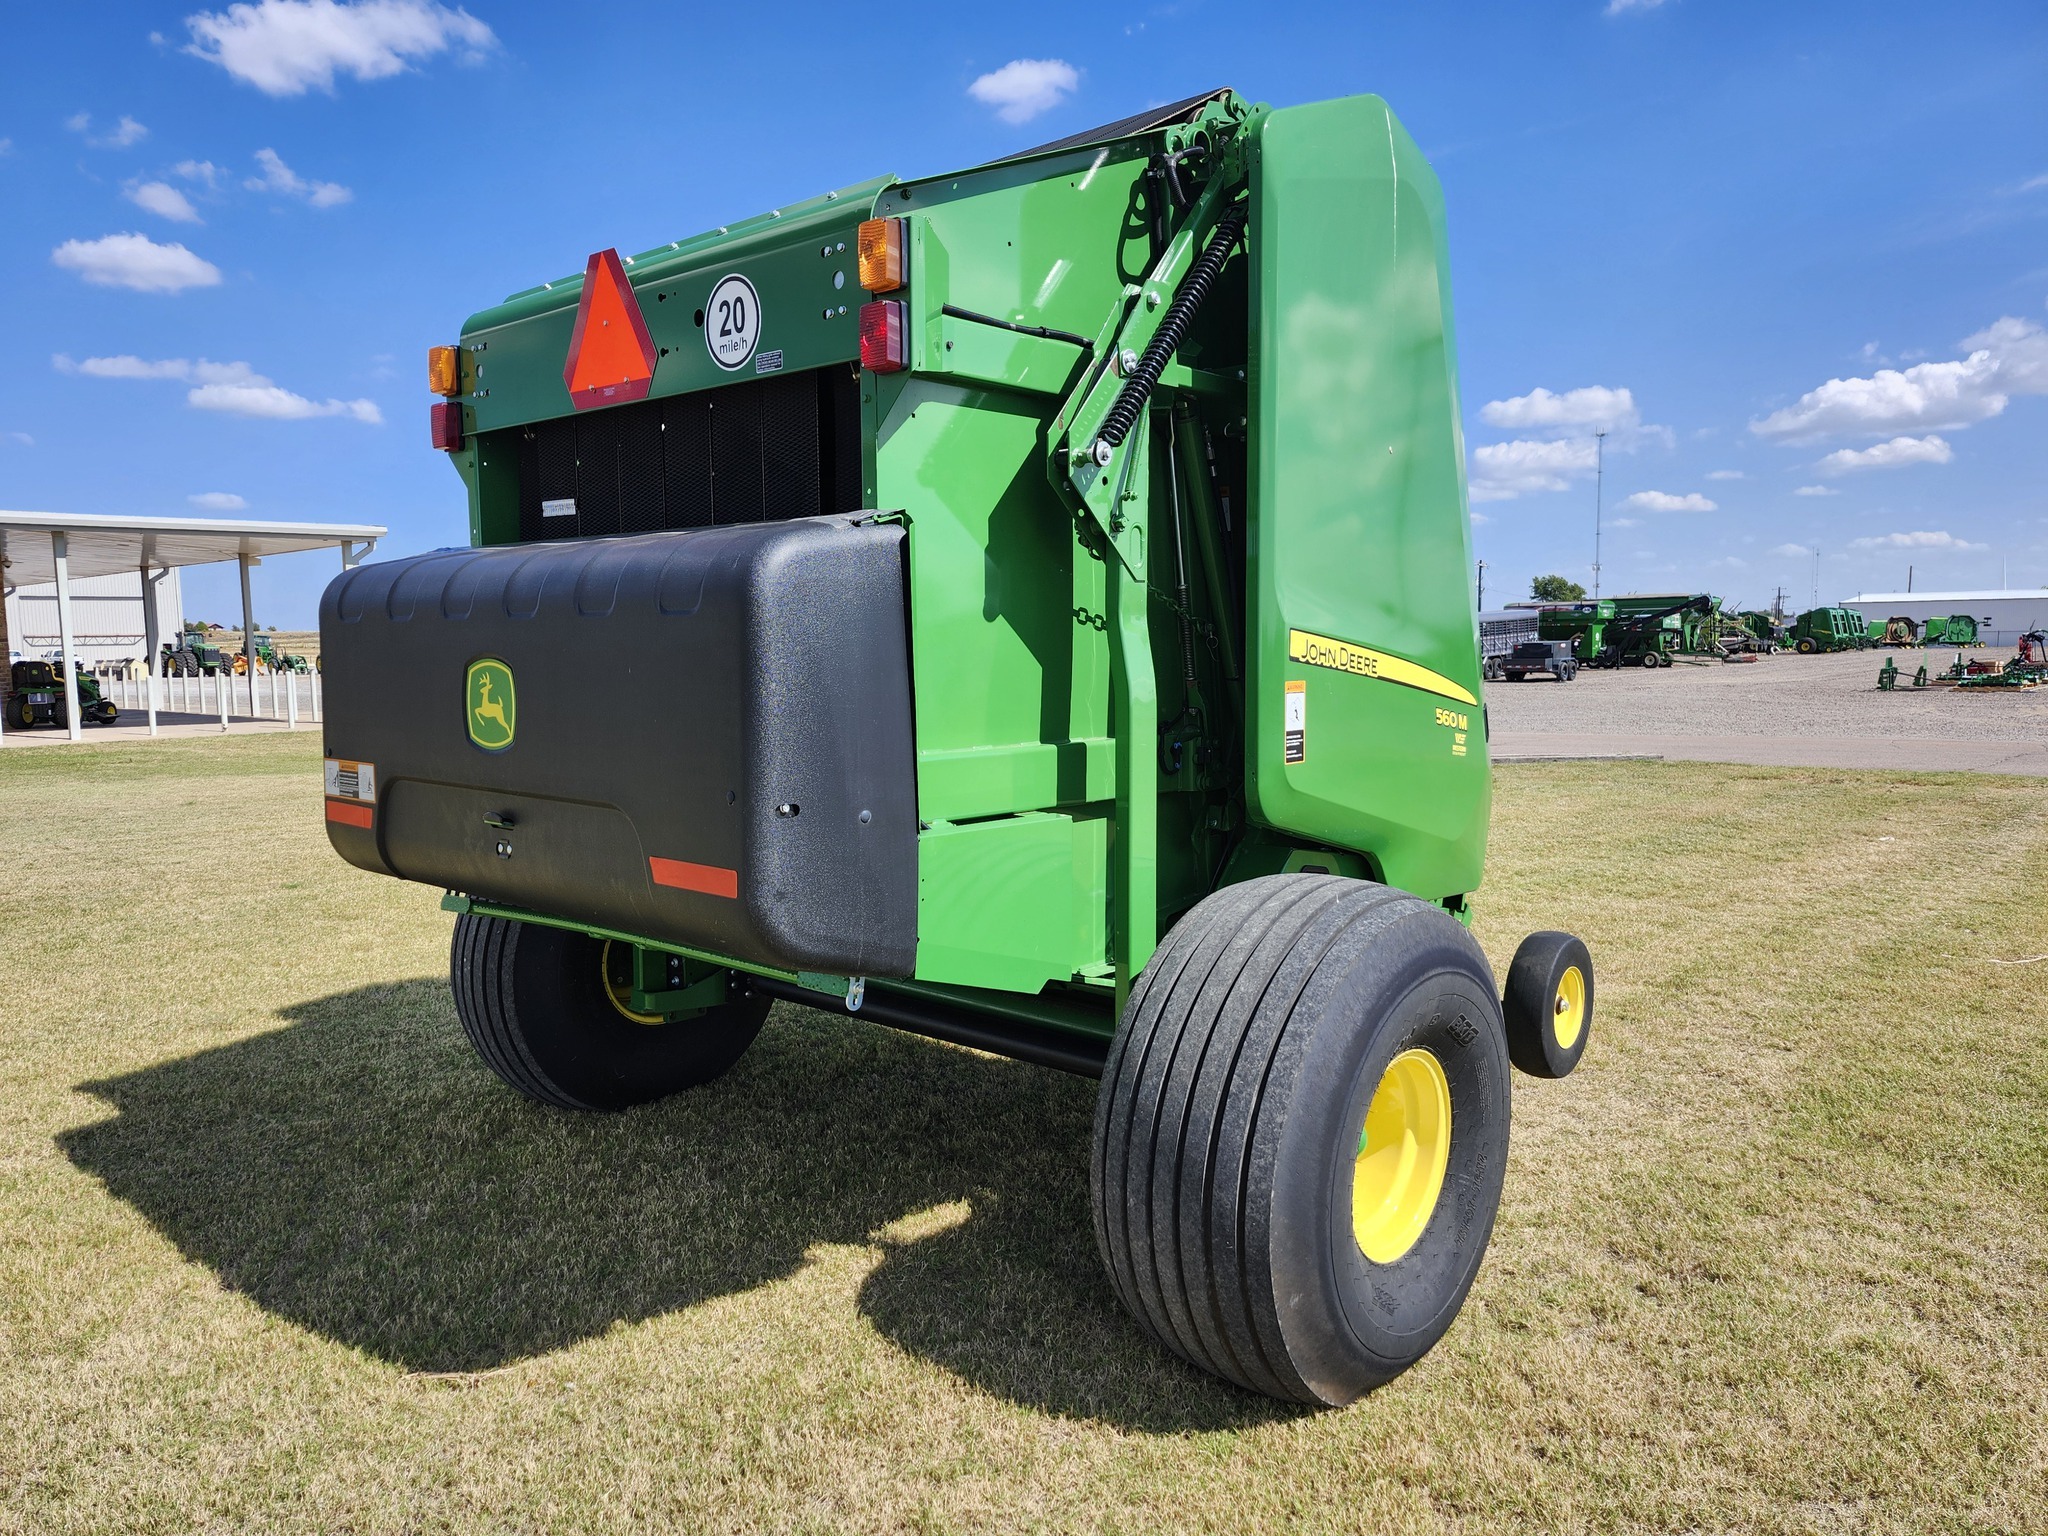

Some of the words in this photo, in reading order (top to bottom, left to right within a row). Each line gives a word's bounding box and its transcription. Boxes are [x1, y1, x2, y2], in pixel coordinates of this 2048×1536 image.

[719, 296, 745, 338] 20
[719, 337, 748, 354] mile/h
[1301, 639, 1337, 665] JOHN
[1339, 647, 1378, 674] DEERE
